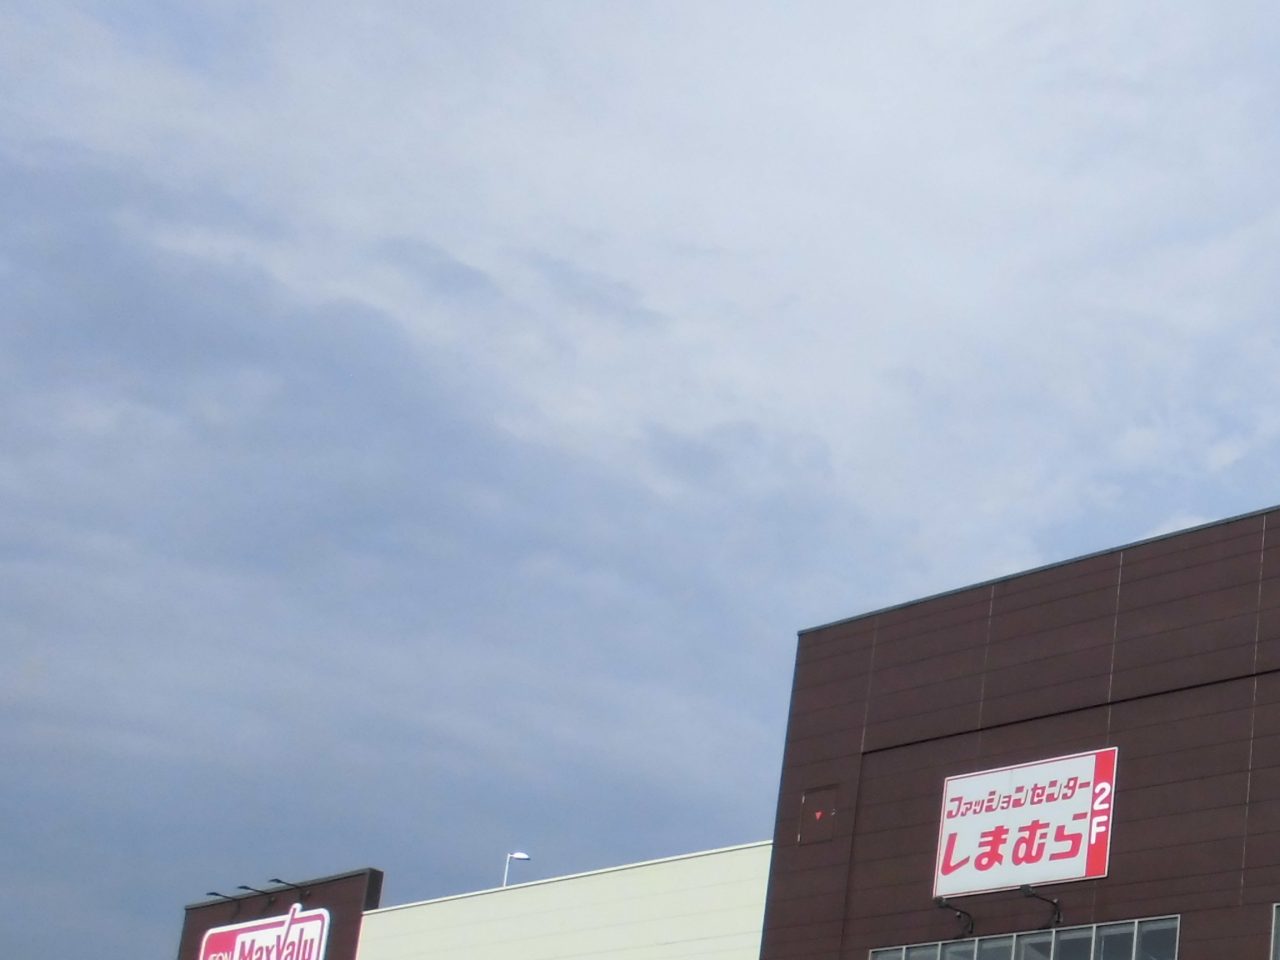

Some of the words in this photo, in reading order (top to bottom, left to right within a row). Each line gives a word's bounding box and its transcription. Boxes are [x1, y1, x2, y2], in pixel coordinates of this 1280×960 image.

[946, 776, 1091, 819] ファッションセンター
[940, 812, 1089, 876] しまむら
